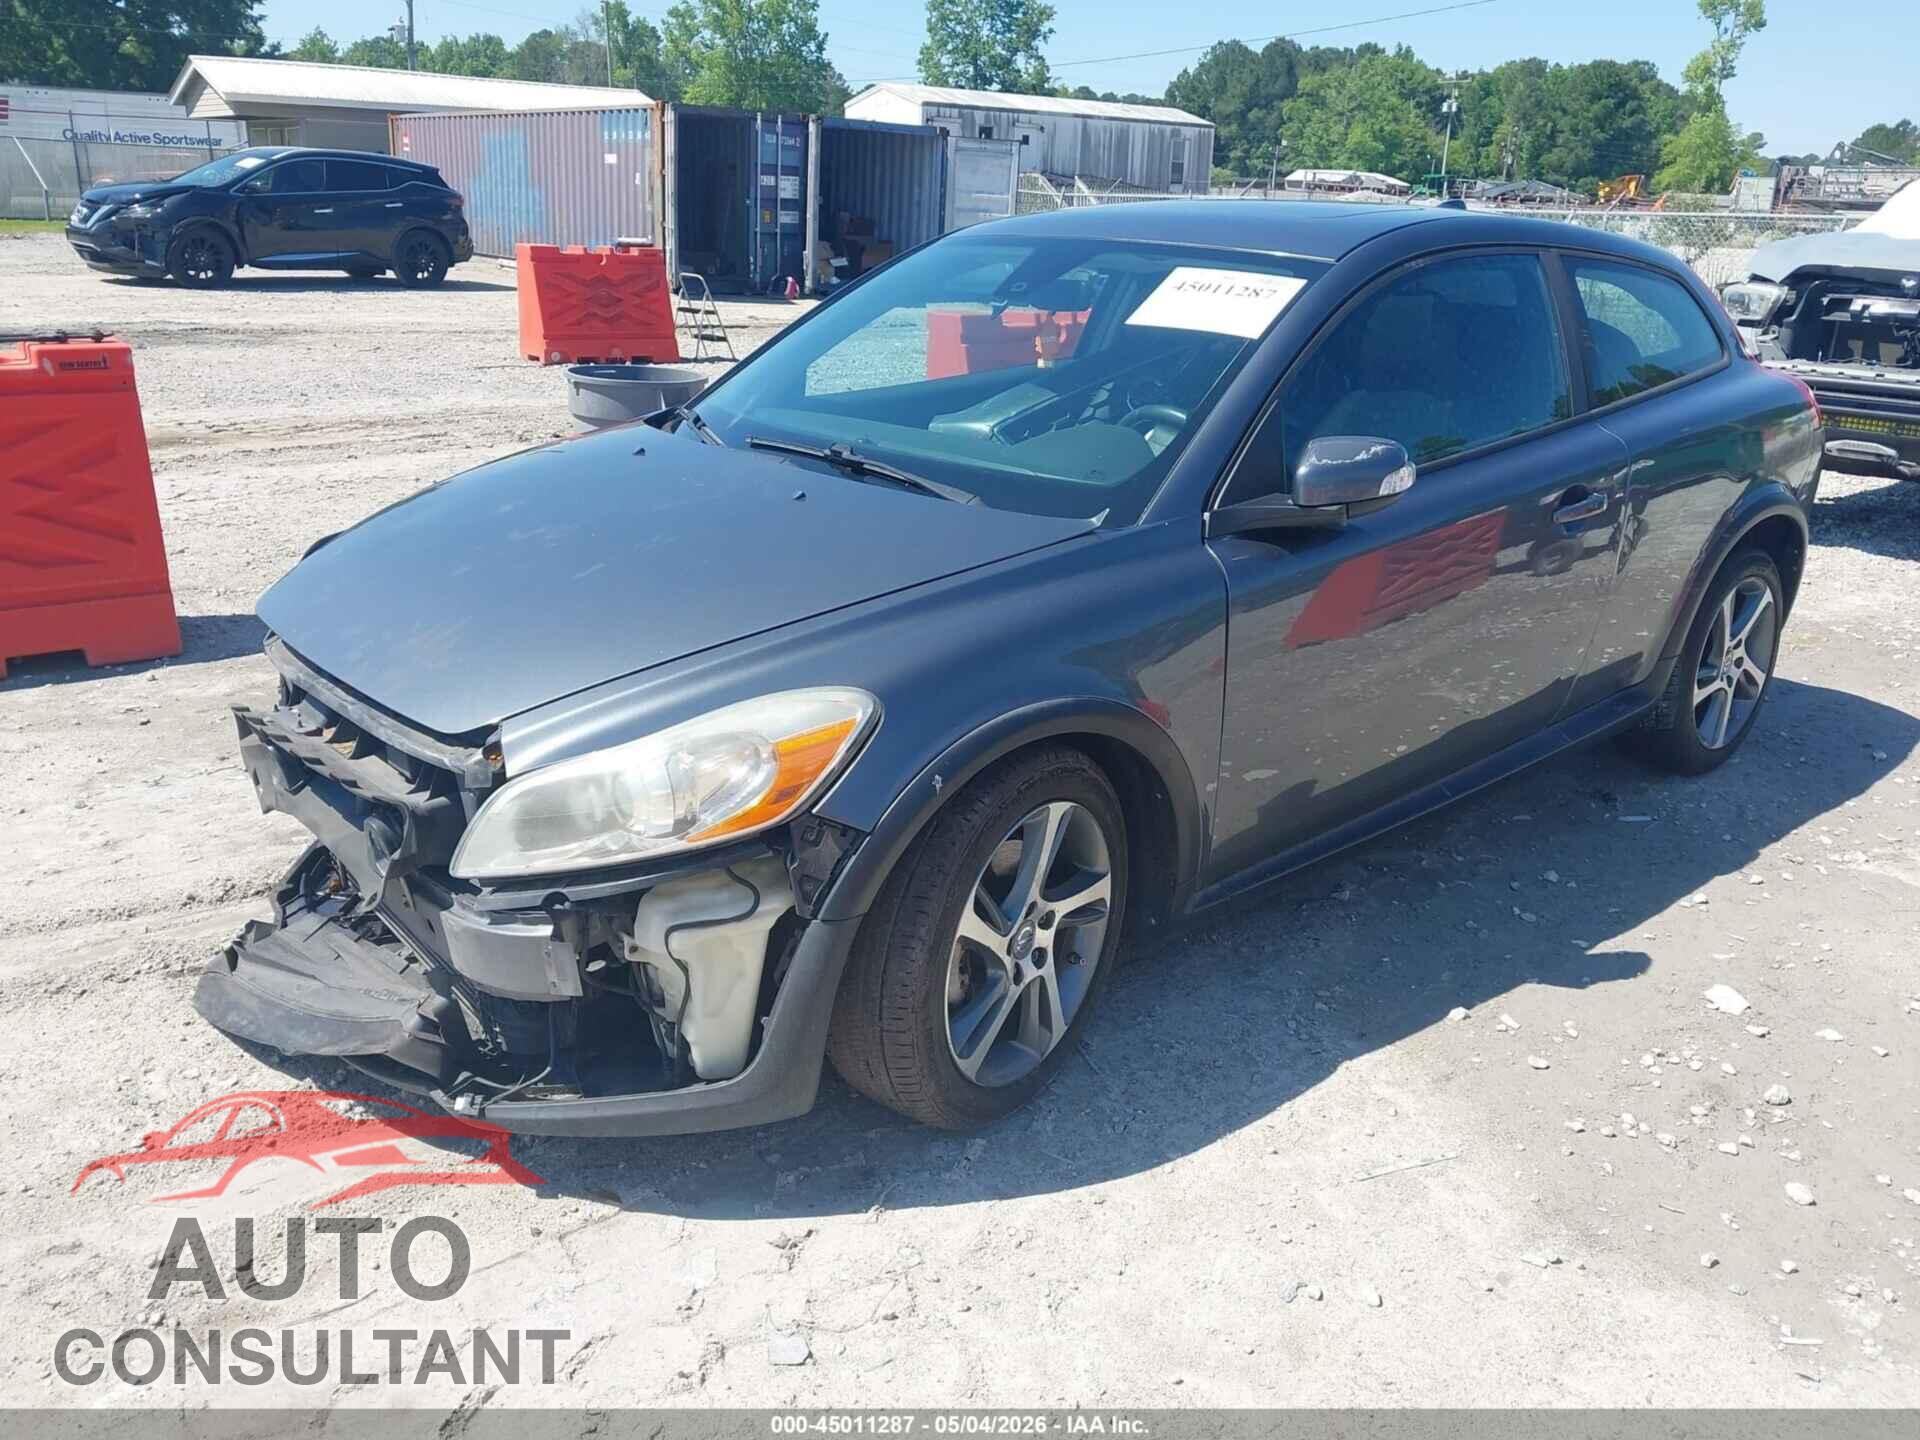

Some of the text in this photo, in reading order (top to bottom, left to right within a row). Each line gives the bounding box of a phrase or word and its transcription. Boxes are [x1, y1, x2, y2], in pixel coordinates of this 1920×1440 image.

[63, 128, 222, 147] Quality Active Sportswear
[1172, 280, 1278, 298] 45011287
